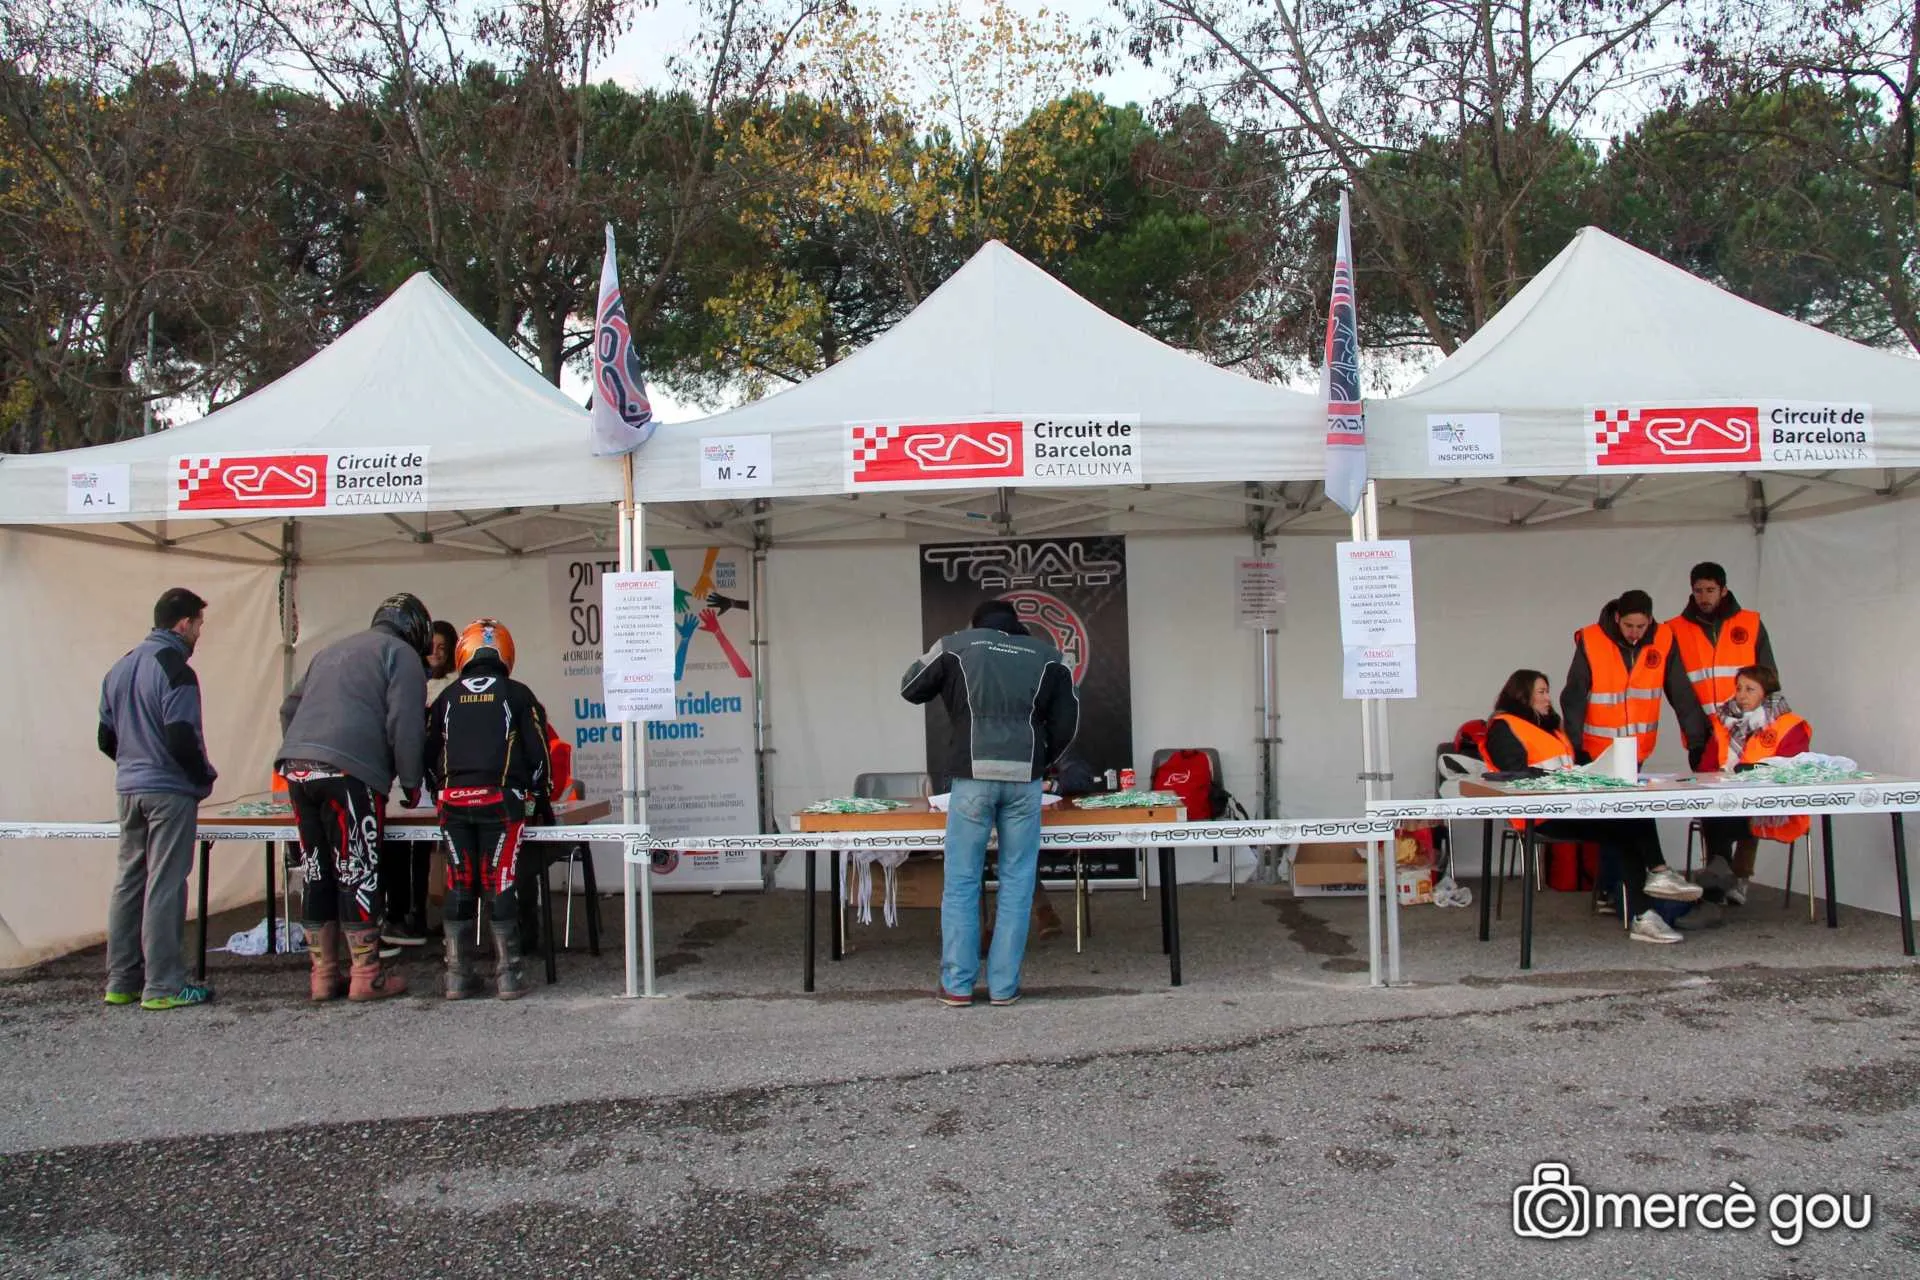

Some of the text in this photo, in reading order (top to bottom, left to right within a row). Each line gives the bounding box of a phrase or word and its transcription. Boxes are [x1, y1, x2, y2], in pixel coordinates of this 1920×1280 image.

[1771, 407, 1865, 424] Circuit de
[1034, 420, 1131, 438] Circuit de
[1773, 427, 1866, 444] Barcelona
[1035, 441, 1132, 458] Barcelona
[1438, 453, 1494, 461] INSCRIPCIONS
[1773, 448, 1868, 461] CATALUNYA
[337, 453, 422, 470] Circuit de
[1035, 462, 1132, 476] CATALUNYA
[336, 471, 423, 488] Barcelona
[718, 467, 731, 480] M
[746, 465, 757, 479] Z
[83, 493, 93, 506] A
[107, 491, 116, 504] L
[335, 491, 422, 506] CATALUNYA
[924, 542, 1121, 582] TRIAL
[675, 690, 742, 716] rialera
[576, 725, 607, 749] per
[647, 720, 704, 742] thom:
[1600, 798, 1713, 814] MOTOCAT
[1742, 792, 1855, 810] MOTOCAT
[1456, 803, 1572, 816] MOTOCAT
[1041, 831, 1121, 844] TOCAT
[1151, 826, 1271, 841] MOTOCAT
[709, 837, 825, 849] MOTOCAT
